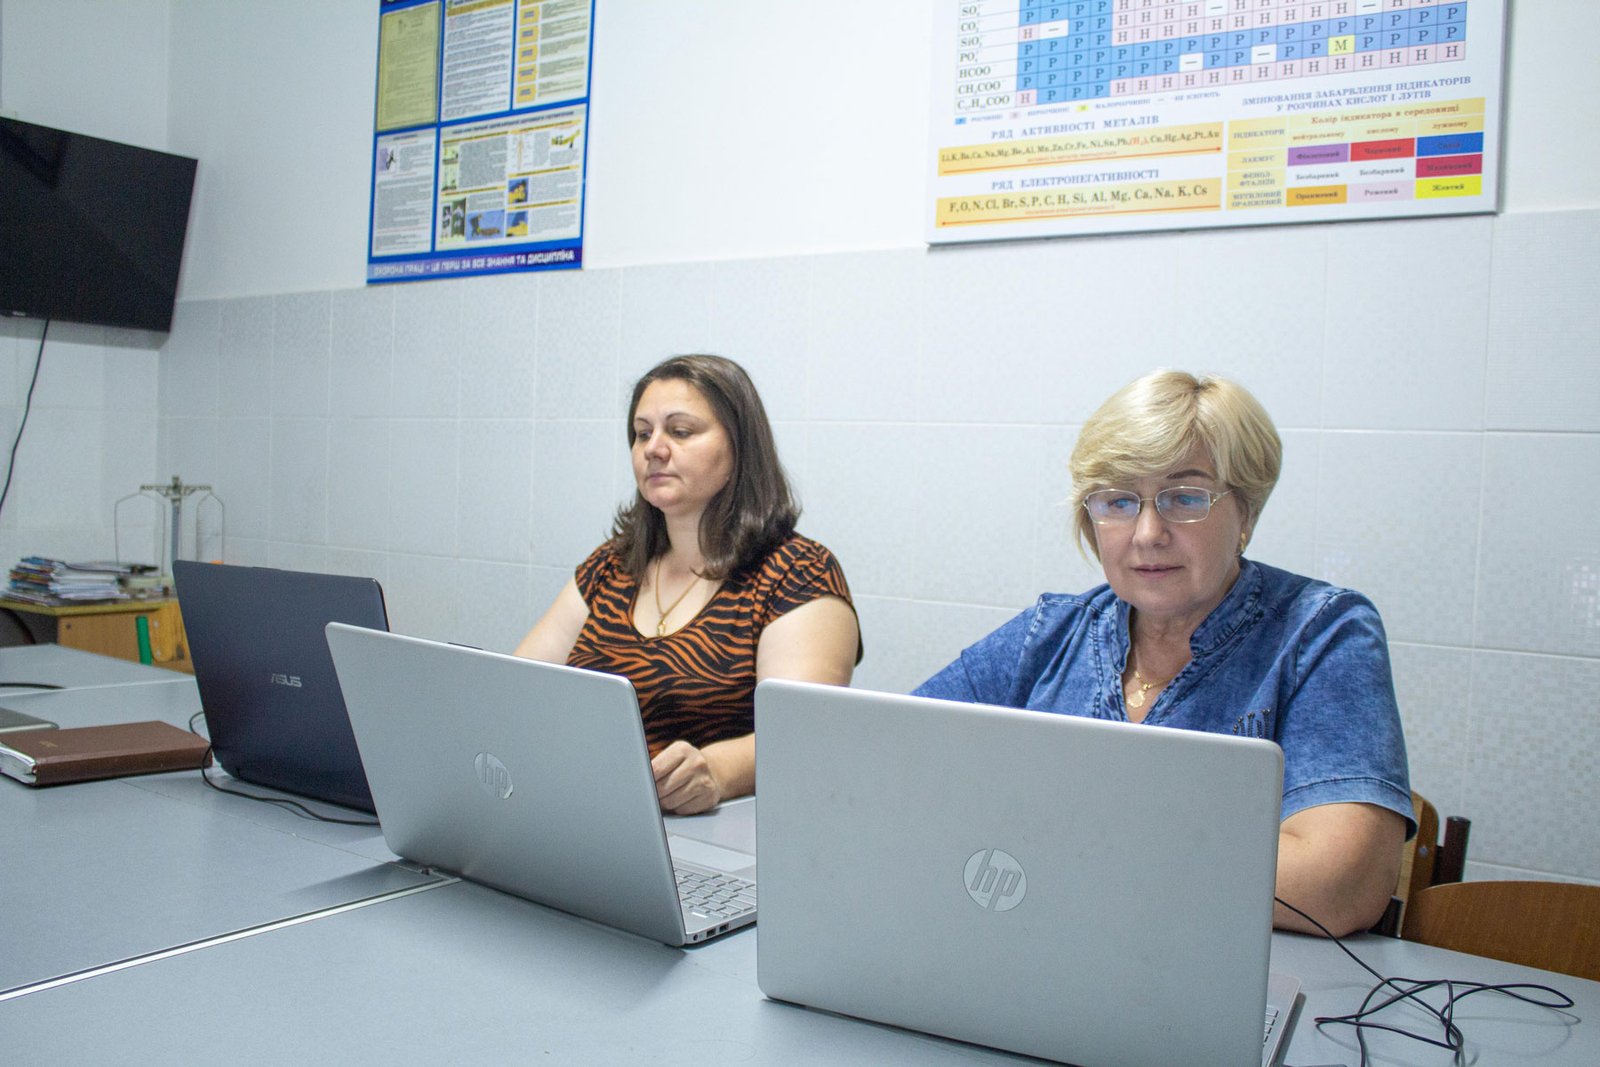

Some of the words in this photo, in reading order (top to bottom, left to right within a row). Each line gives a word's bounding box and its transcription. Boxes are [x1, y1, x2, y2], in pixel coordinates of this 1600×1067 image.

[1315, 84, 1393, 99] ЗАБАРВЛЕННЯ
[1395, 76, 1471, 91] ІНДИКАТОРІВ
[1287, 98, 1342, 111] РОЗЧИНАХ
[1346, 95, 1387, 106] КИСЛОТ
[1340, 110, 1392, 122] індикатора
[1405, 105, 1459, 117] середовищі
[991, 129, 1013, 139] РЯД
[1021, 121, 1096, 137] АКТИВНОСТІ
[1104, 116, 1159, 129] МЕТАЛІВ
[992, 180, 1013, 190] РЯД
[1020, 169, 1159, 188] ЕЛЕКТРОНЕГАТИВНОСТІ
[516, 256, 526, 266] ТА
[271, 673, 302, 688] ASUS
[477, 751, 509, 798] hp
[968, 848, 1023, 911] hp
